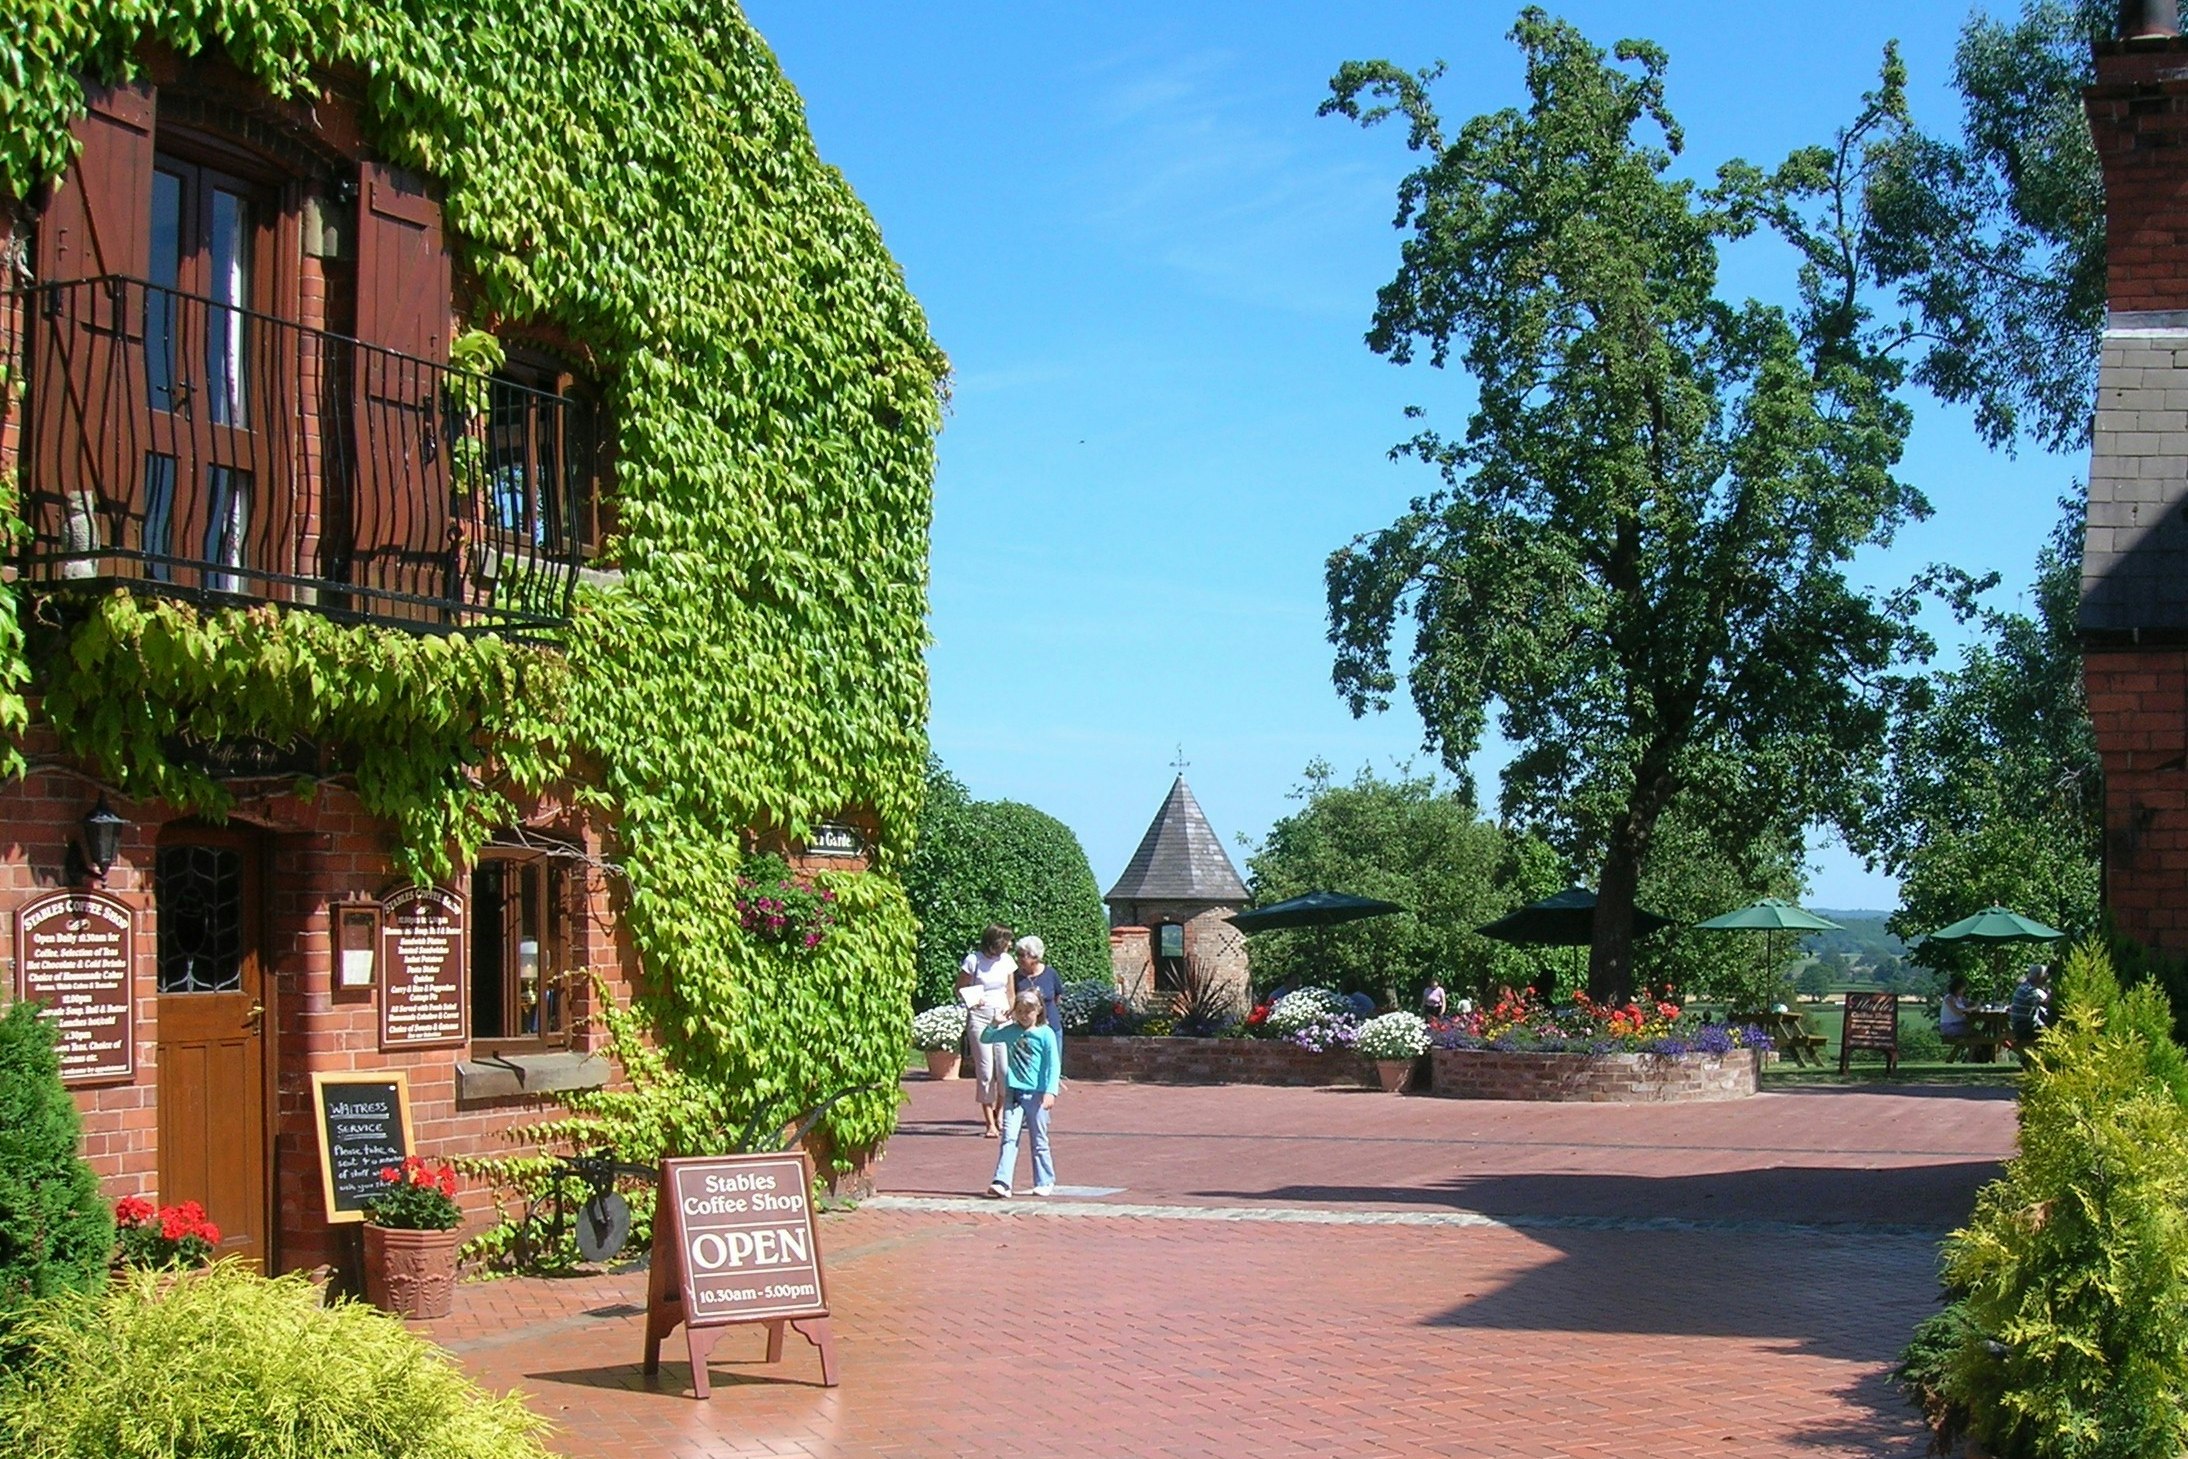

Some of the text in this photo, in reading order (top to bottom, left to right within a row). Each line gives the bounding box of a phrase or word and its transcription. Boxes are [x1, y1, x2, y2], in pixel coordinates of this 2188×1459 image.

[385, 890, 414, 915] STABLES
[24, 899, 129, 932] STABLES COFFEE SHOP
[33, 932, 56, 946] Open
[56, 932, 77, 945] Daily
[60, 947, 93, 958] Selection
[26, 960, 40, 970] Hot
[41, 960, 76, 970] Chocolate
[84, 959, 102, 969] Cold
[102, 959, 127, 969] Drinks
[28, 972, 53, 982] Choice
[62, 971, 102, 981] Homemade
[329, 1101, 388, 1115] WAITRESS
[336, 1123, 384, 1134] SERVICE
[333, 1144, 362, 1157] Please
[704, 1173, 777, 1194] Stables
[684, 1193, 804, 1216] Coffee Shop
[691, 1228, 808, 1270] OPEN
